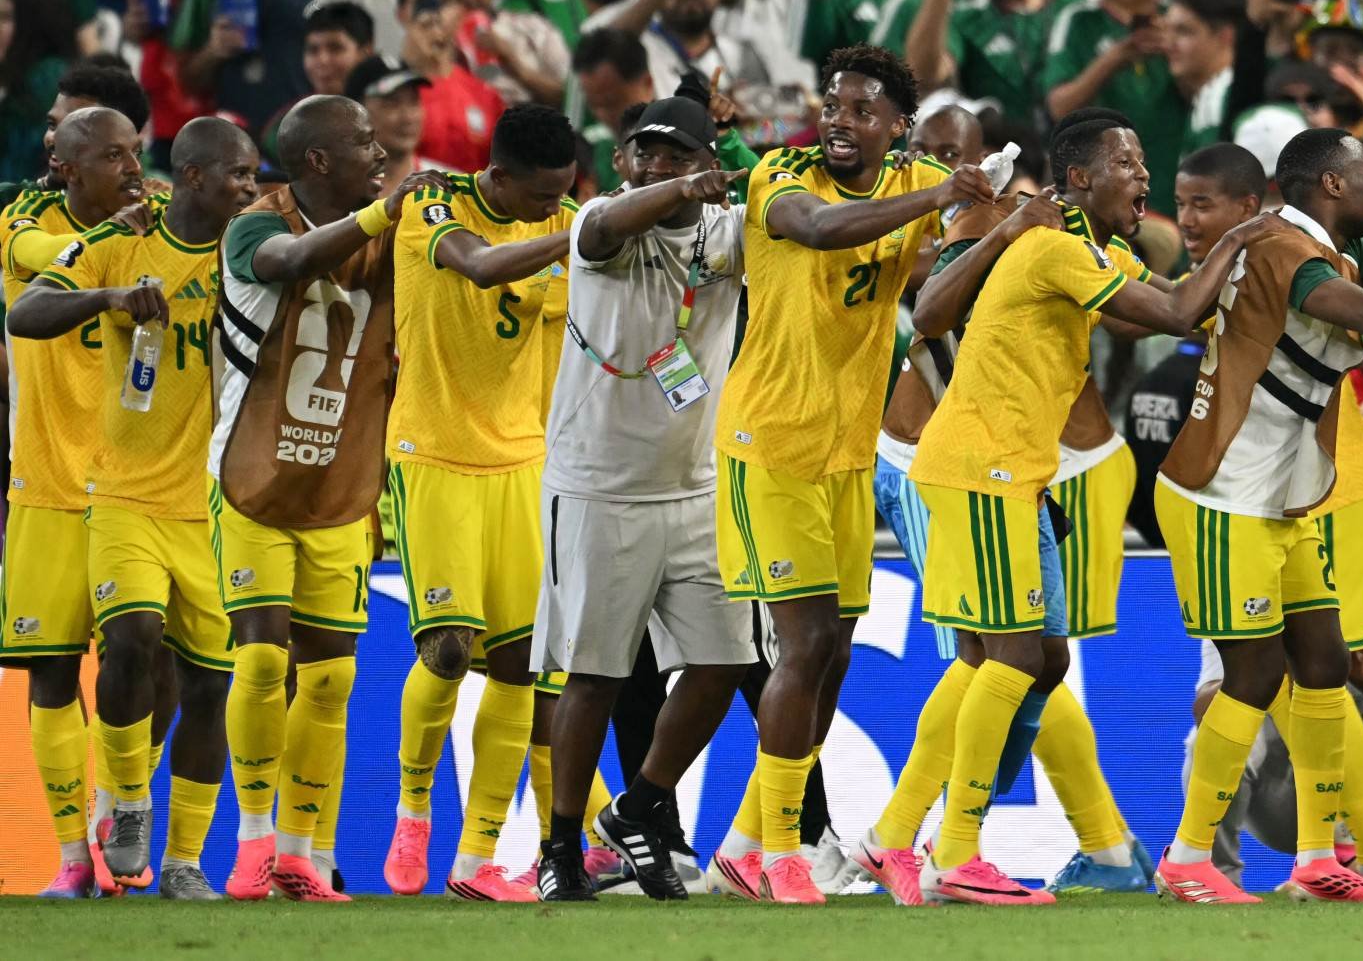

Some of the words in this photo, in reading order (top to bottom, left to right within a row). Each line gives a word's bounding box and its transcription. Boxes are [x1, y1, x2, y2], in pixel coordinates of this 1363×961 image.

[495, 292, 521, 339] 5
[173, 318, 211, 370] 14
[139, 346, 156, 386] smart
[1195, 379, 1214, 398] CUP
[307, 394, 341, 414] FIF
[280, 424, 334, 445] WORLD
[276, 440, 337, 467] 202
[47, 778, 82, 794] SAFA
